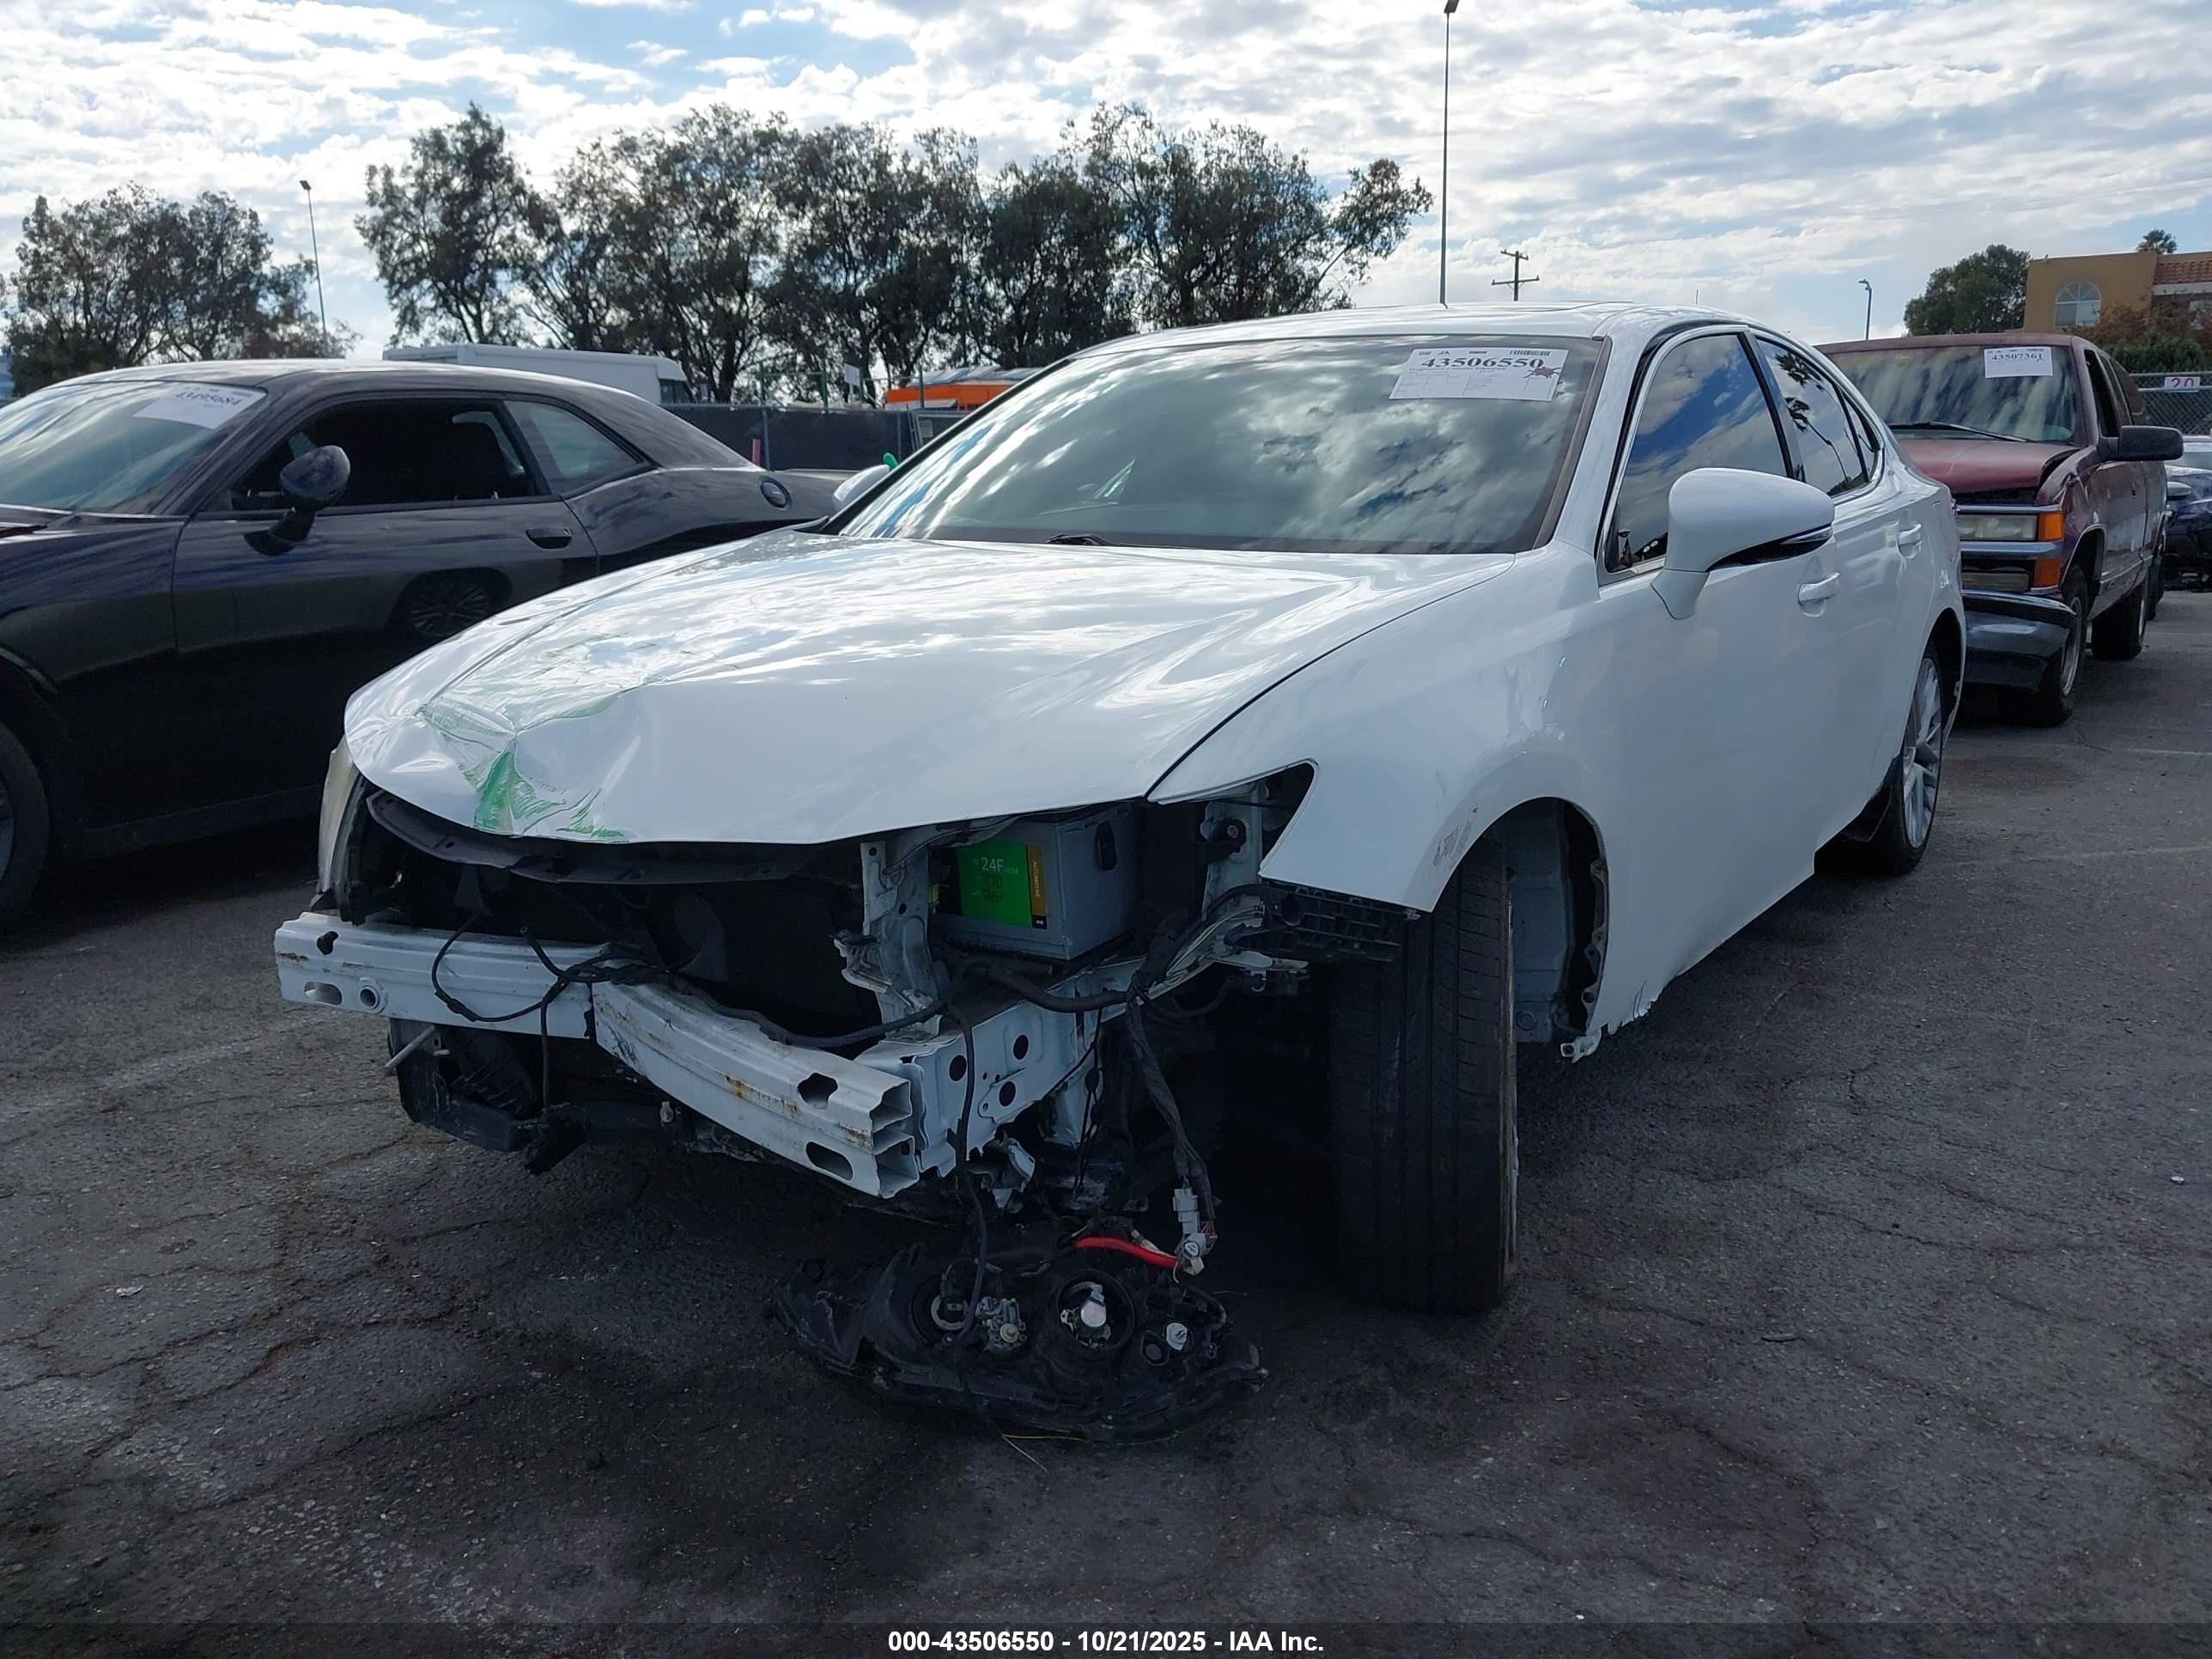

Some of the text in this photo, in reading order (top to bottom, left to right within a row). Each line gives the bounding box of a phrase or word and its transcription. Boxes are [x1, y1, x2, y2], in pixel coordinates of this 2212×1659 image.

[1420, 357, 1545, 368] 43506550
[981, 857, 1004, 872] 24F
[983, 874, 1003, 888] 710
